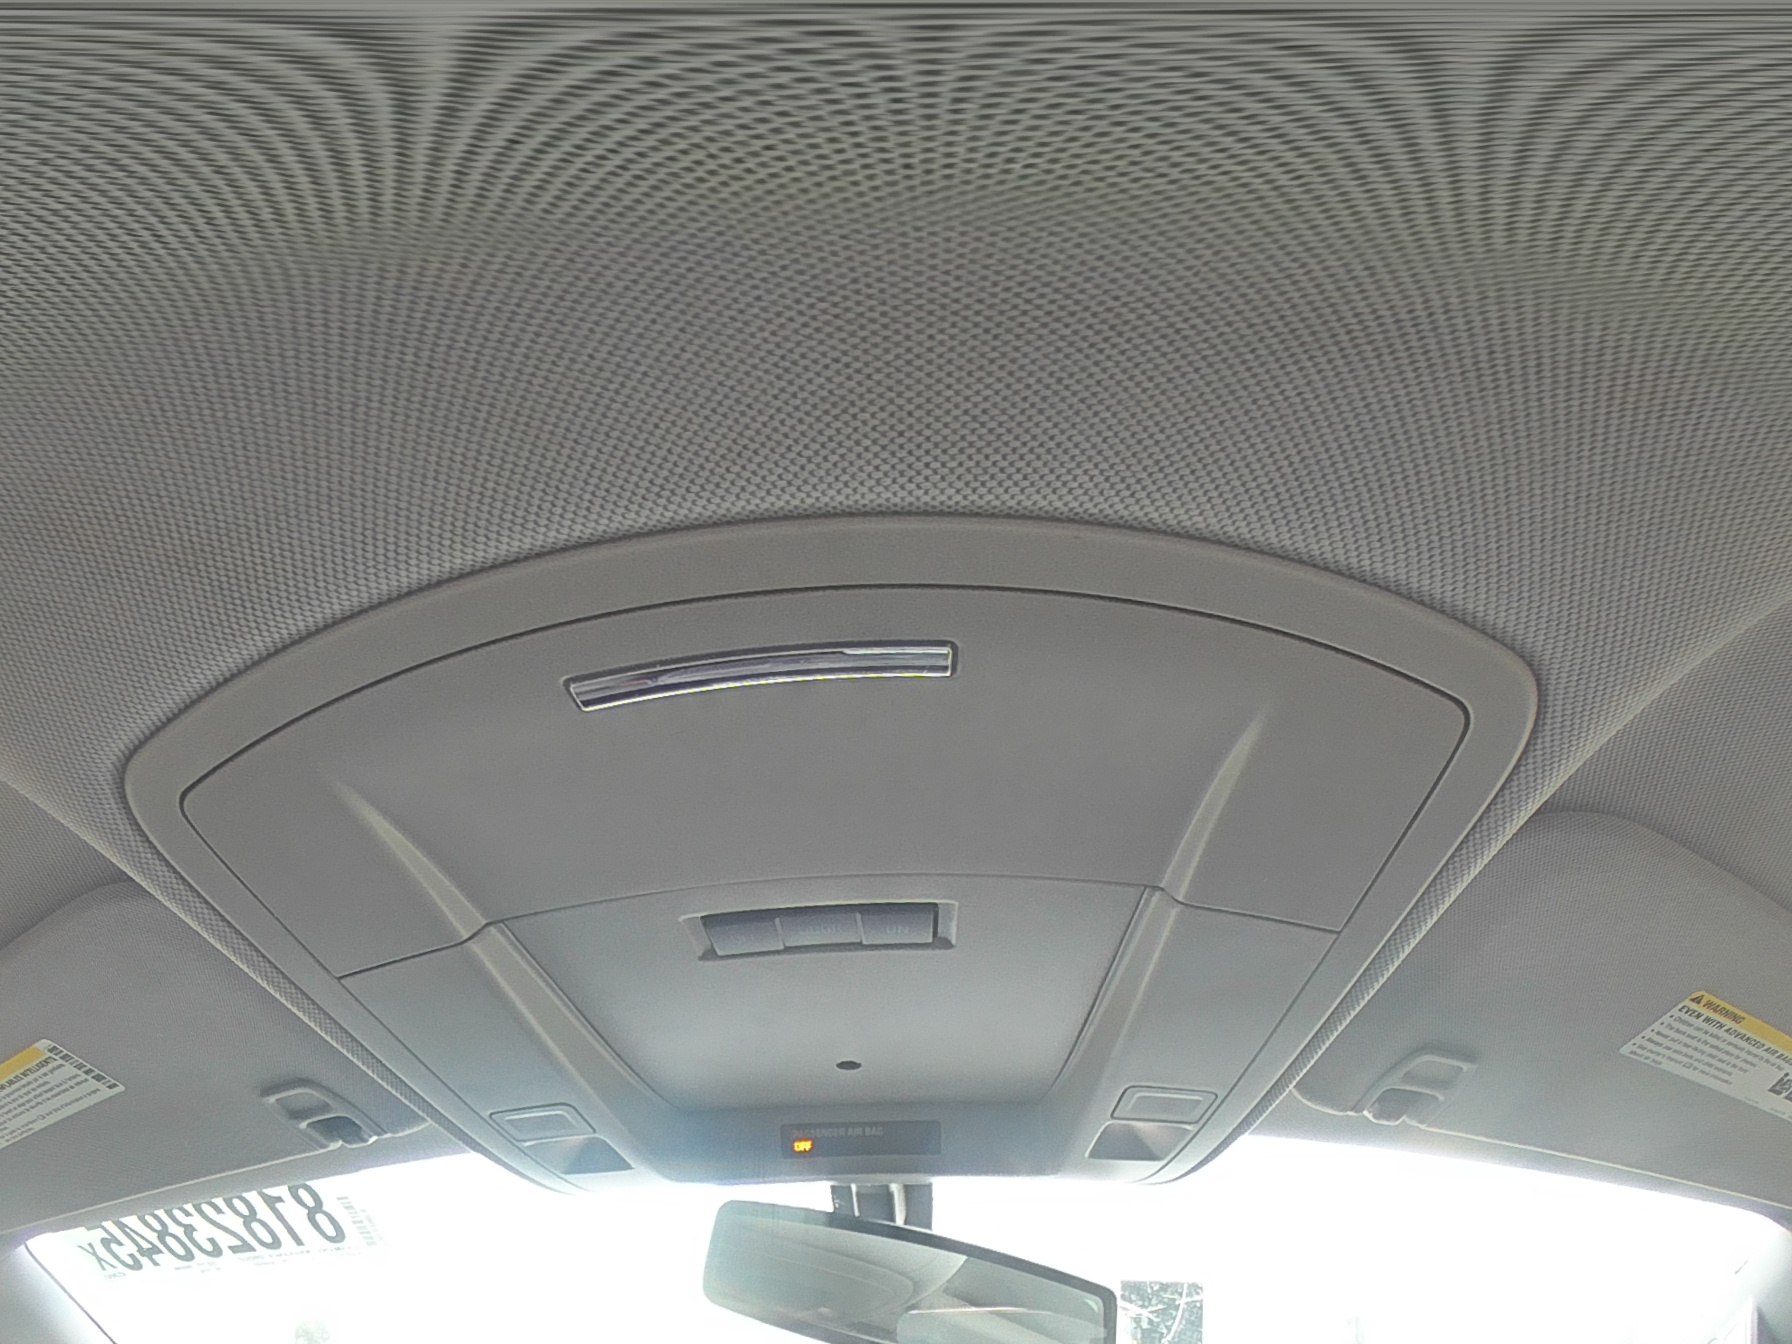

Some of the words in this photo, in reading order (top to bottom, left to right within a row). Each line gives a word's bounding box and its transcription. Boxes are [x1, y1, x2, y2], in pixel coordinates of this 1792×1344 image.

[886, 926, 908, 935] ON
[1702, 999, 1746, 1025] WARNING
[1678, 1004, 1704, 1020] EVEN
[1702, 1015, 1727, 1031] WITH
[1724, 1026, 1766, 1051] ADVANCED
[1761, 1044, 1779, 1056] AIR
[791, 1128, 846, 1138] PASSENGER
[847, 1127, 863, 1137] AIR
[865, 1126, 885, 1136] BAG
[793, 1140, 813, 1152] OFF
